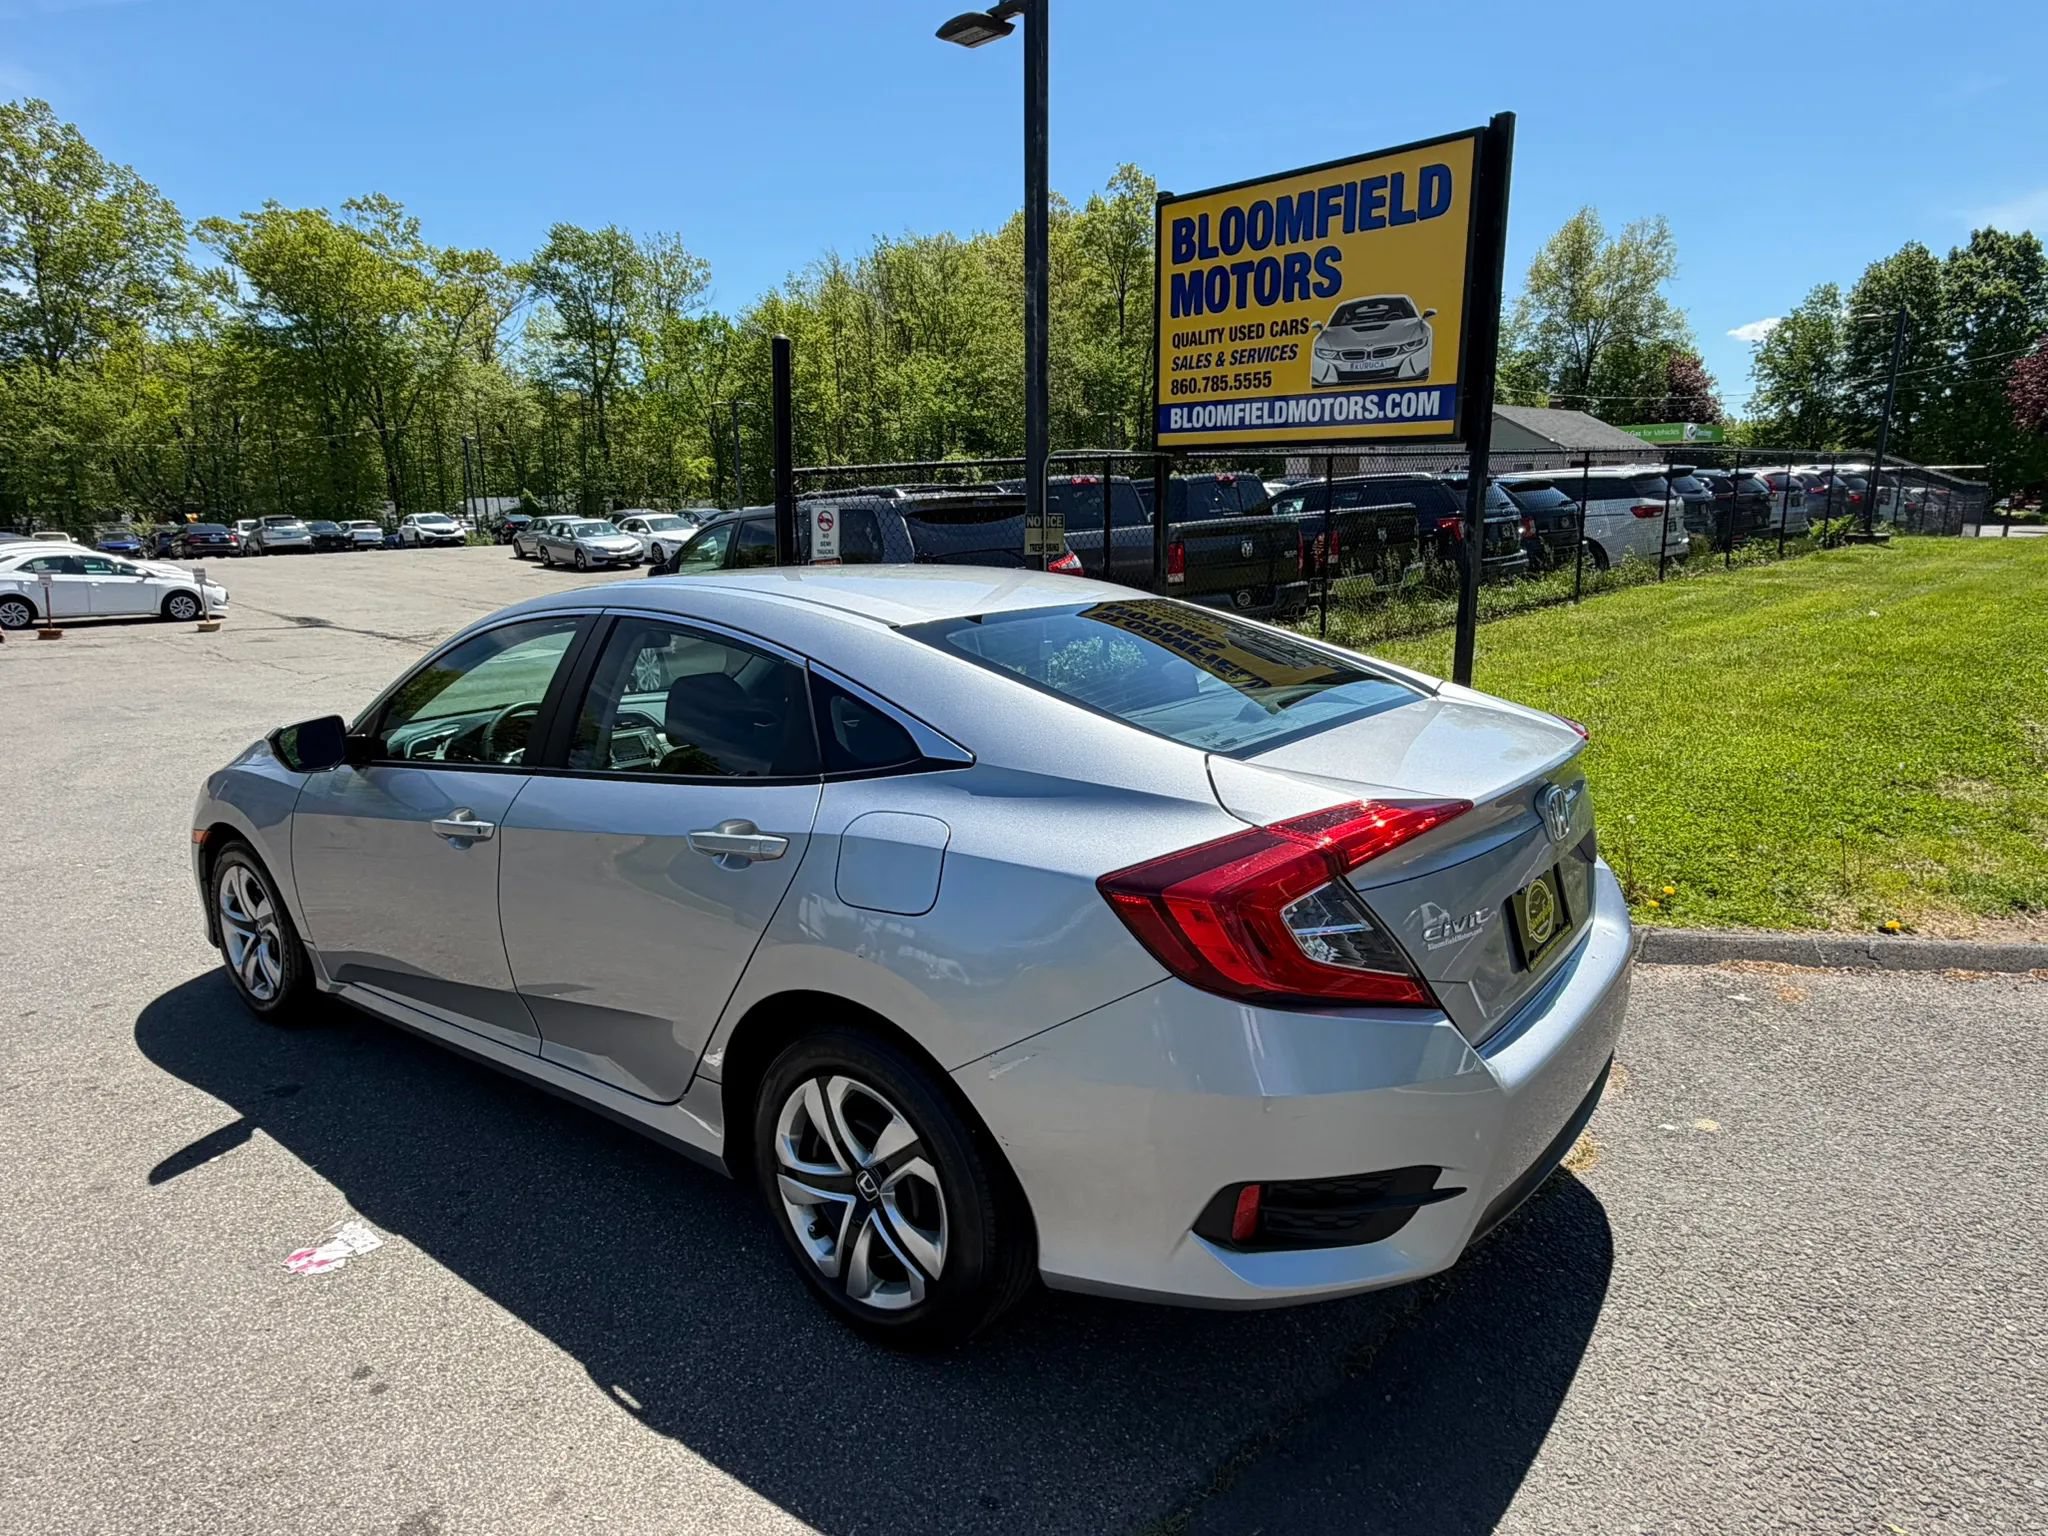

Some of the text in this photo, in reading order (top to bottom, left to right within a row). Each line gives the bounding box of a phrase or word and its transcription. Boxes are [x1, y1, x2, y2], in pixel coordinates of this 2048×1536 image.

[1171, 163, 1453, 265] BLOOMFIELD
[1170, 246, 1342, 319] MOTORS
[1172, 318, 1309, 349] QUALITY USED CARS
[1171, 343, 1299, 372] SALES & SERVICES
[1171, 371, 1272, 396] 860.785.5555
[1170, 391, 1441, 430] BLOOMFIELDMOTORS.COM
[1026, 515, 1063, 528] NOICE
[1423, 907, 1489, 941] CIVIC
